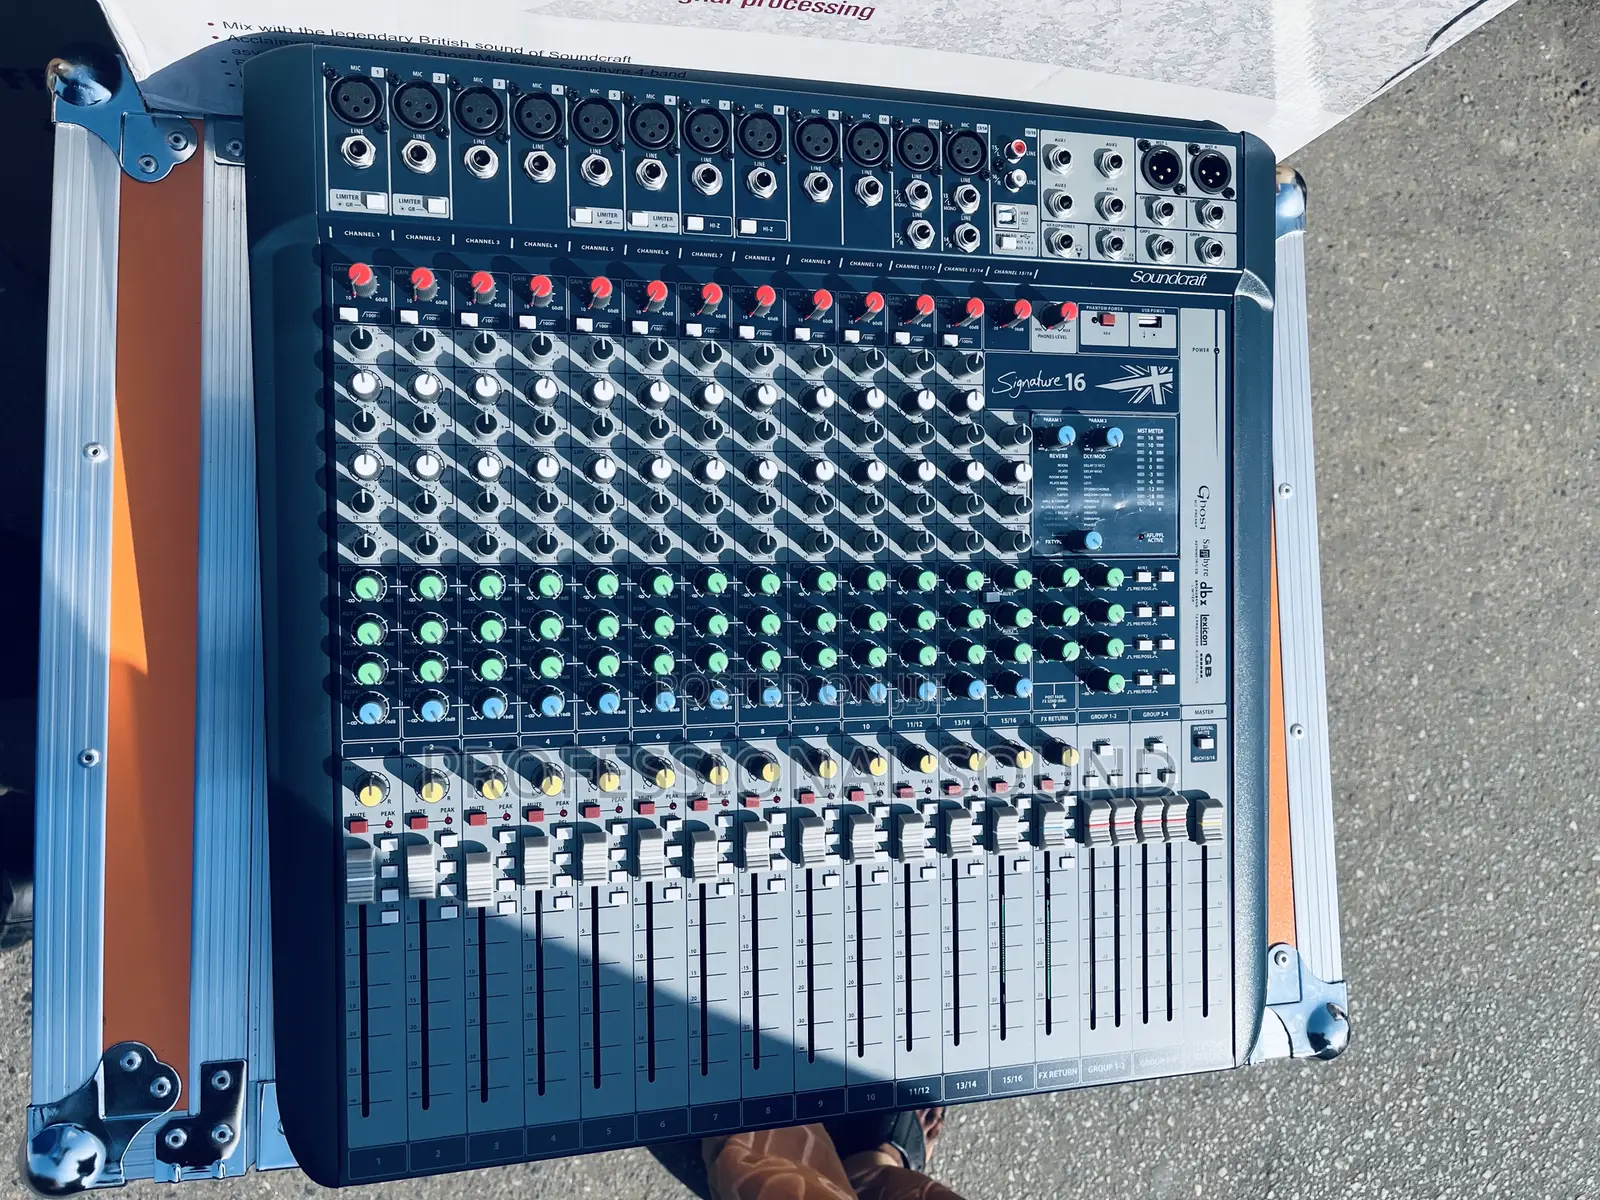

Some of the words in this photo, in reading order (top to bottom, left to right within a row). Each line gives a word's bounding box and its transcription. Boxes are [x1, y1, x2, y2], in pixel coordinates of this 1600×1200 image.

[741, 0, 876, 21] processing
[223, 21, 252, 30] Mix
[258, 25, 292, 34] with
[299, 27, 325, 36] the
[331, 29, 413, 43] legendary
[420, 35, 469, 48] British
[475, 42, 523, 55] sound
[529, 49, 545, 57] of
[549, 51, 631, 63] Soundcraft
[635, 68, 688, 78] 4-band
[335, 193, 359, 201] LIMITER
[1131, 270, 1208, 286] Soundcraft
[992, 369, 1066, 398] Signature
[1065, 372, 1086, 392] 16
[1200, 582, 1213, 605] dbx
[1200, 614, 1210, 646] lexicon
[1205, 653, 1212, 677] GB
[1038, 1070, 1047, 1080] FX
[1049, 1067, 1077, 1078] RETURN
[1088, 1064, 1112, 1074] GROUP
[1002, 1074, 1023, 1084] 15/16
[955, 1079, 977, 1090] 13/14
[909, 1086, 930, 1096] 11/12
[818, 1100, 823, 1108] 9
[765, 1106, 771, 1115] 8
[713, 1112, 718, 1121] 7
[660, 1120, 666, 1128] 6
[606, 1127, 612, 1136] 5
[550, 1134, 556, 1142] 4
[494, 1142, 499, 1150] 3
[435, 1150, 441, 1158] 2
[376, 1157, 381, 1166] 1
